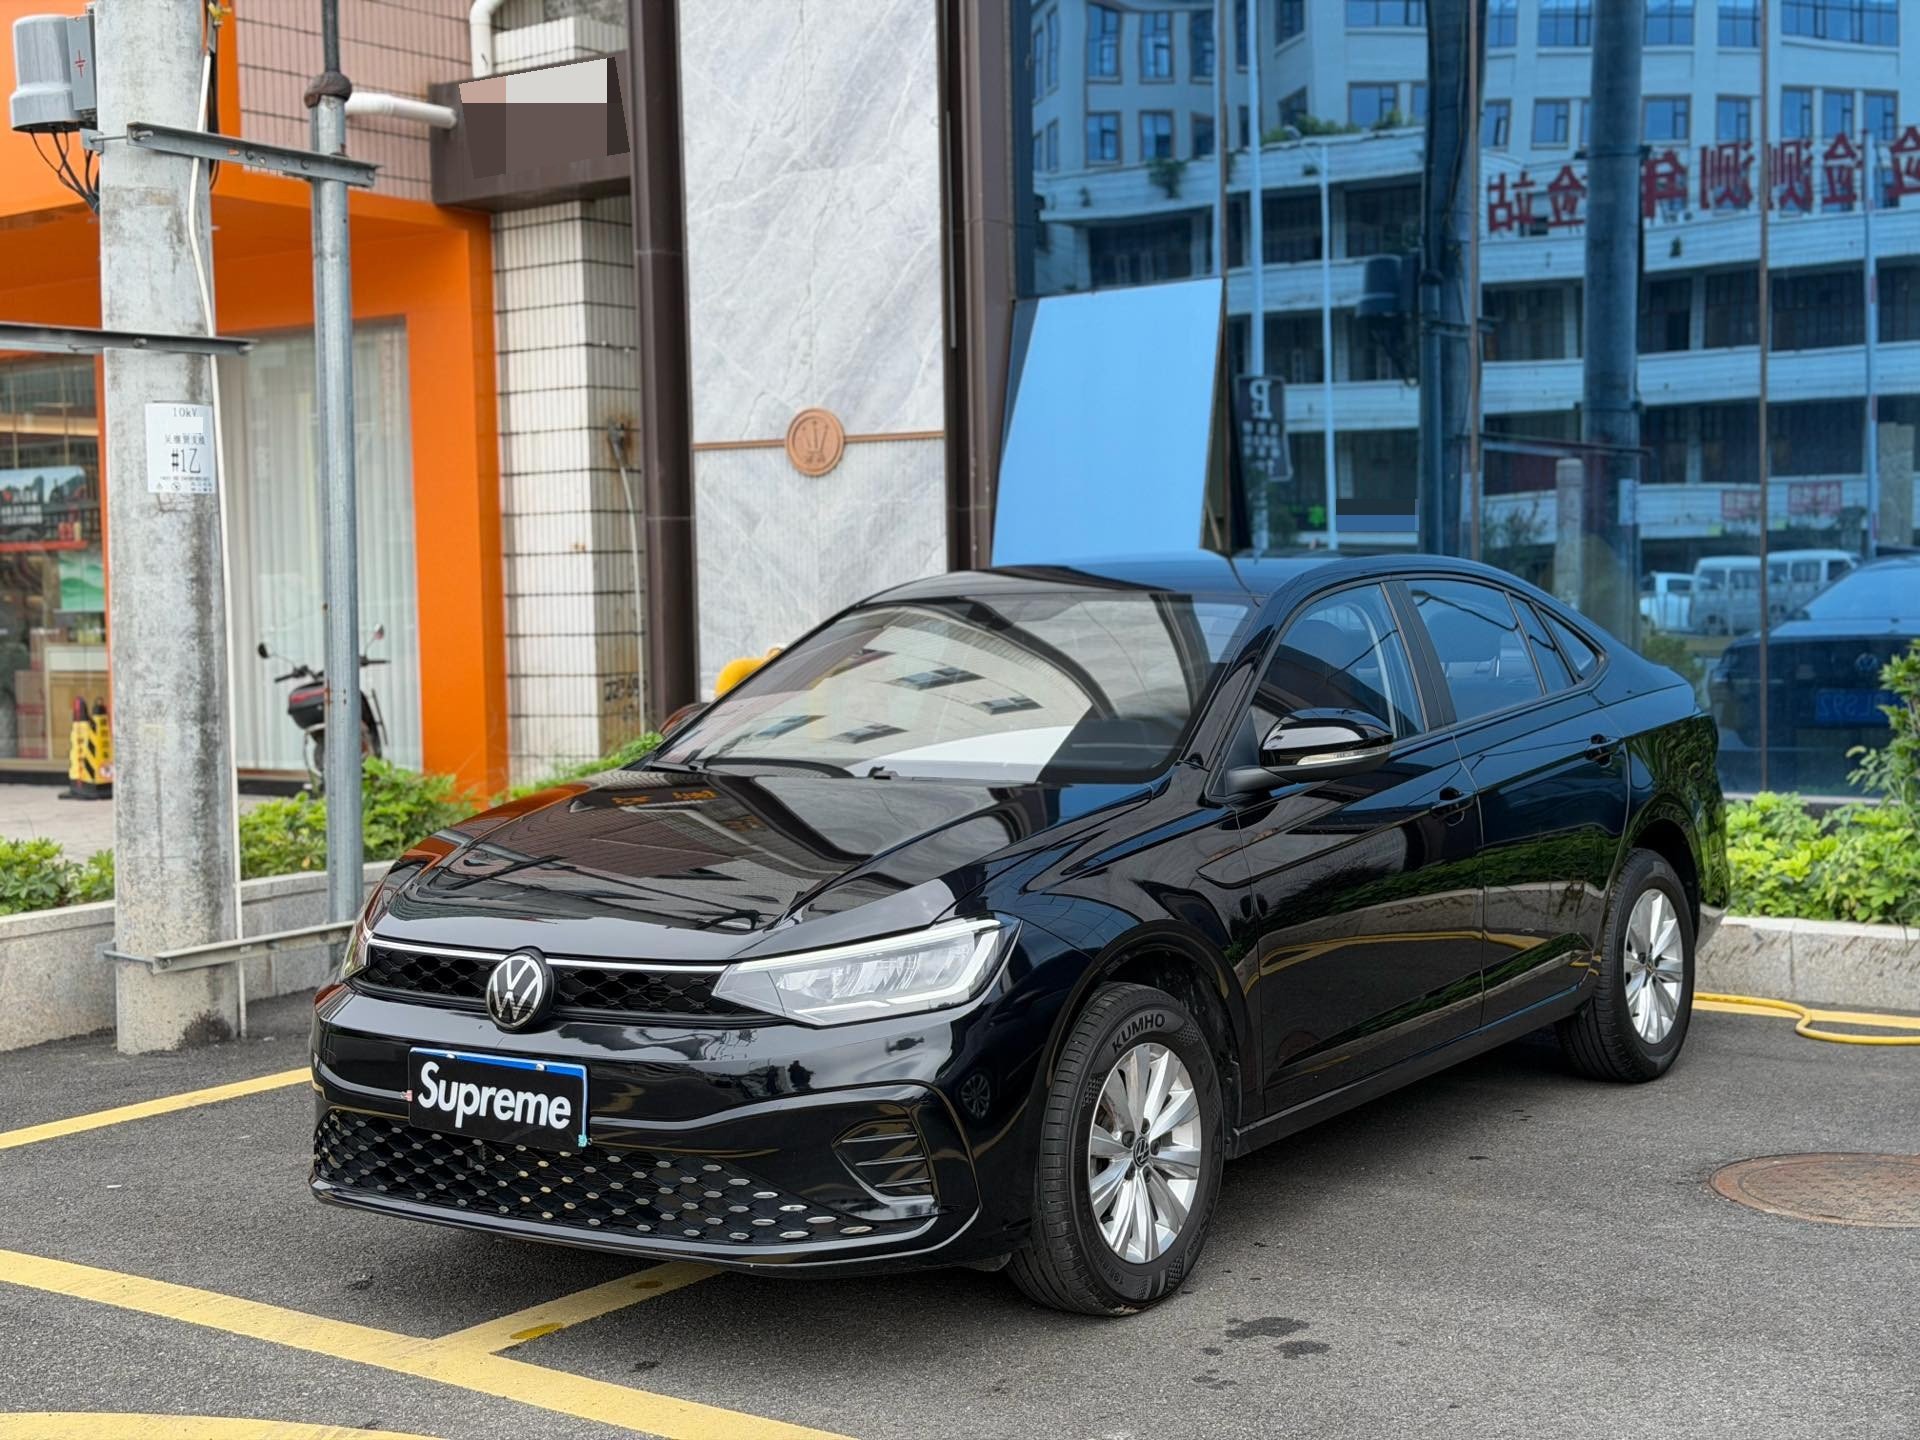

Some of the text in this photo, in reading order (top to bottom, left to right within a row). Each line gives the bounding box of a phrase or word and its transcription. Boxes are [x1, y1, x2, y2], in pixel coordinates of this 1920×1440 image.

[173, 407, 198, 417] 10kV
[1111, 1013, 1165, 1054] KUMHO
[418, 1061, 571, 1130] Supreme
